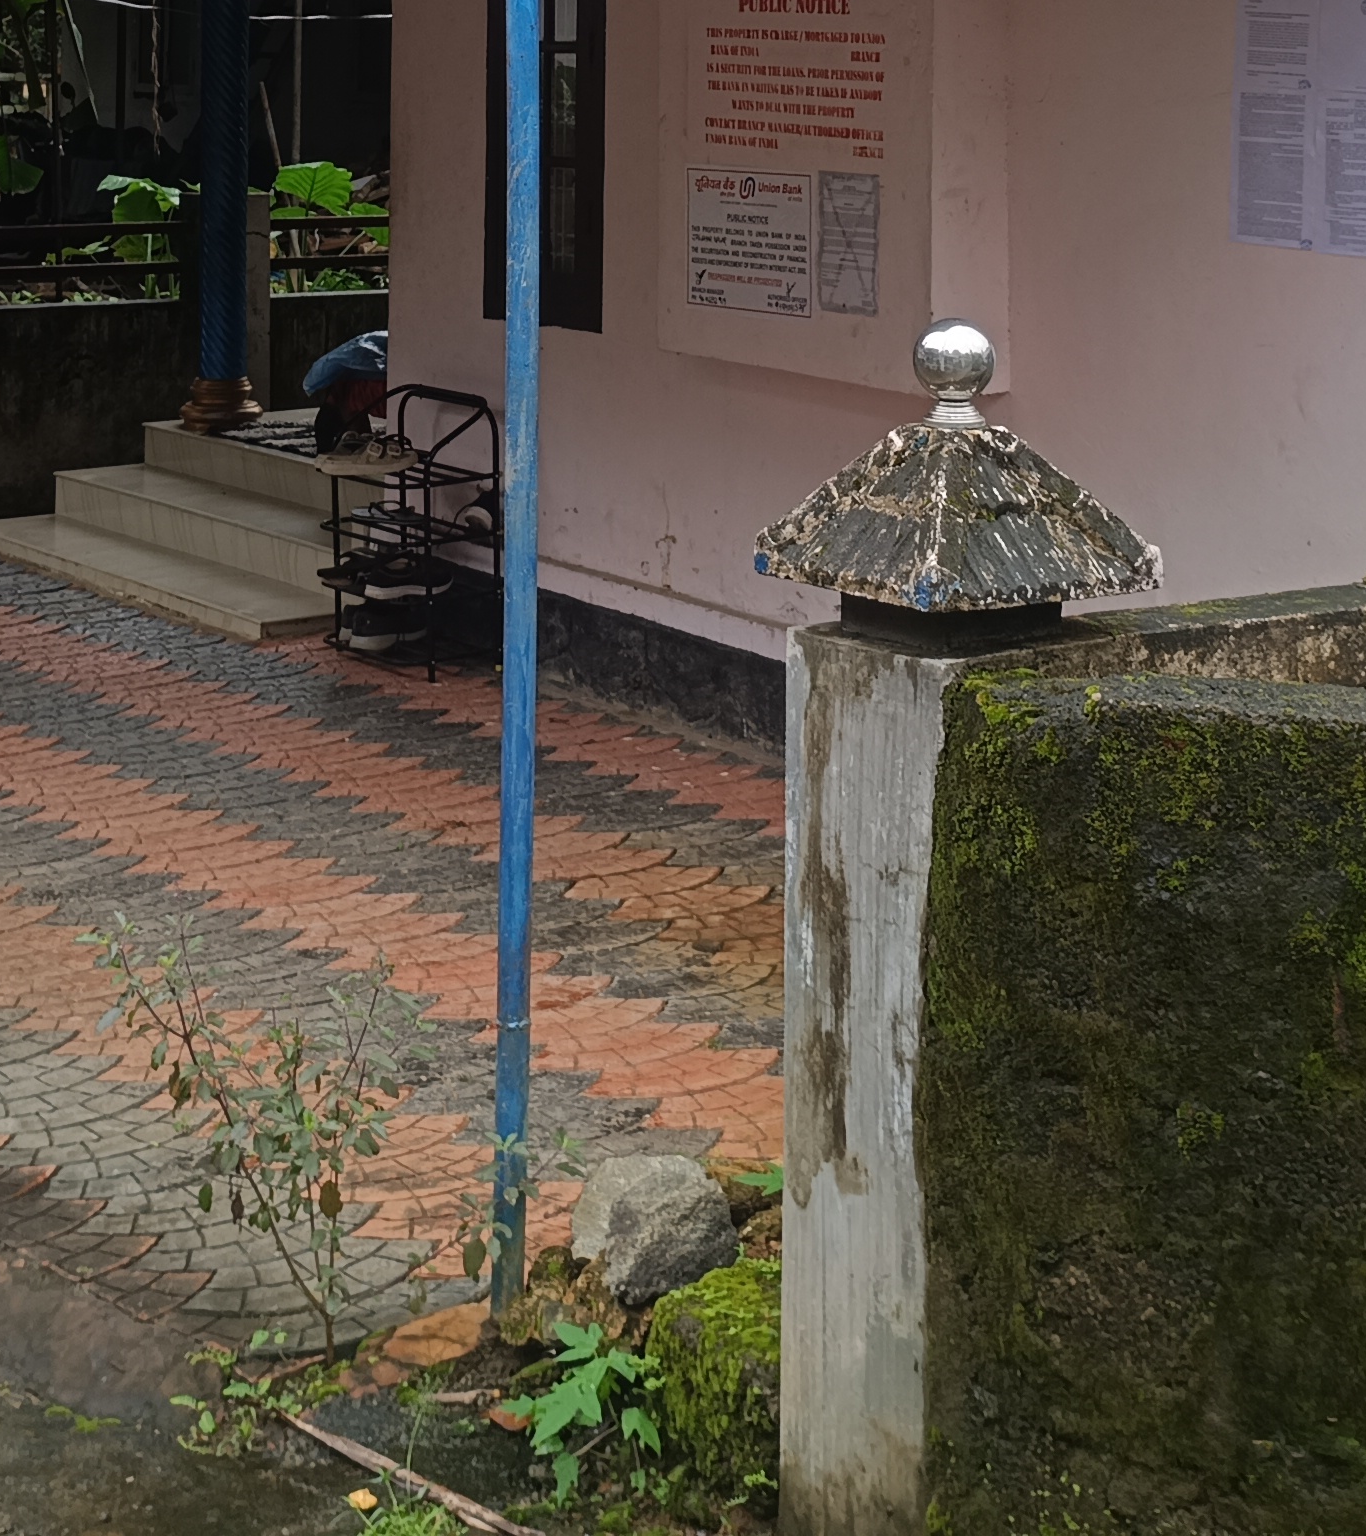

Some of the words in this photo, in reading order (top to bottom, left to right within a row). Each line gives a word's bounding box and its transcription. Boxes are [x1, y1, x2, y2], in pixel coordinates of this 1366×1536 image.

[707, 28, 722, 37] THIS
[724, 29, 759, 39] PROPERTY
[762, 29, 768, 38] IS
[805, 31, 848, 43] MORTGAGED
[851, 33, 860, 43] TO
[862, 33, 885, 44] UNION
[711, 45, 729, 55] BANK
[730, 46, 738, 55] OF
[741, 46, 759, 56] INDIA
[851, 51, 880, 62] BRANCH
[707, 63, 713, 72] IS
[715, 63, 719, 73] A
[721, 64, 751, 75] SECURITY
[754, 65, 766, 76] FOR
[768, 66, 781, 76] THE
[808, 68, 829, 79] PRIOR
[831, 69, 873, 81] PERMISSION
[875, 72, 884, 82] OF
[708, 80, 720, 90] THE
[722, 81, 739, 91] BANK
[742, 82, 748, 92] IN
[751, 83, 778, 94] WRITING
[781, 84, 794, 95] HAS
[796, 86, 803, 95] TO
[806, 86, 814, 96] BE
[817, 87, 839, 98] TAKEN
[841, 88, 847, 98] IF
[850, 89, 882, 101] ANYBODY
[732, 99, 754, 111] WANTS
[756, 101, 764, 111] TO
[765, 102, 781, 113] DEAL
[783, 103, 801, 114] WITH
[803, 105, 816, 115] THE
[818, 106, 855, 118] PROPERTY
[705, 117, 735, 129] CONTACT
[852, 129, 883, 141] OFFICER
[705, 133, 726, 144] UNION
[729, 136, 746, 146] BANK
[748, 137, 757, 147] OF
[759, 138, 778, 149] INDIA
[759, 182, 780, 193] Union
[782, 184, 802, 194] Bank
[727, 214, 746, 223] PUBLIC
[748, 216, 768, 224] NOTICE
